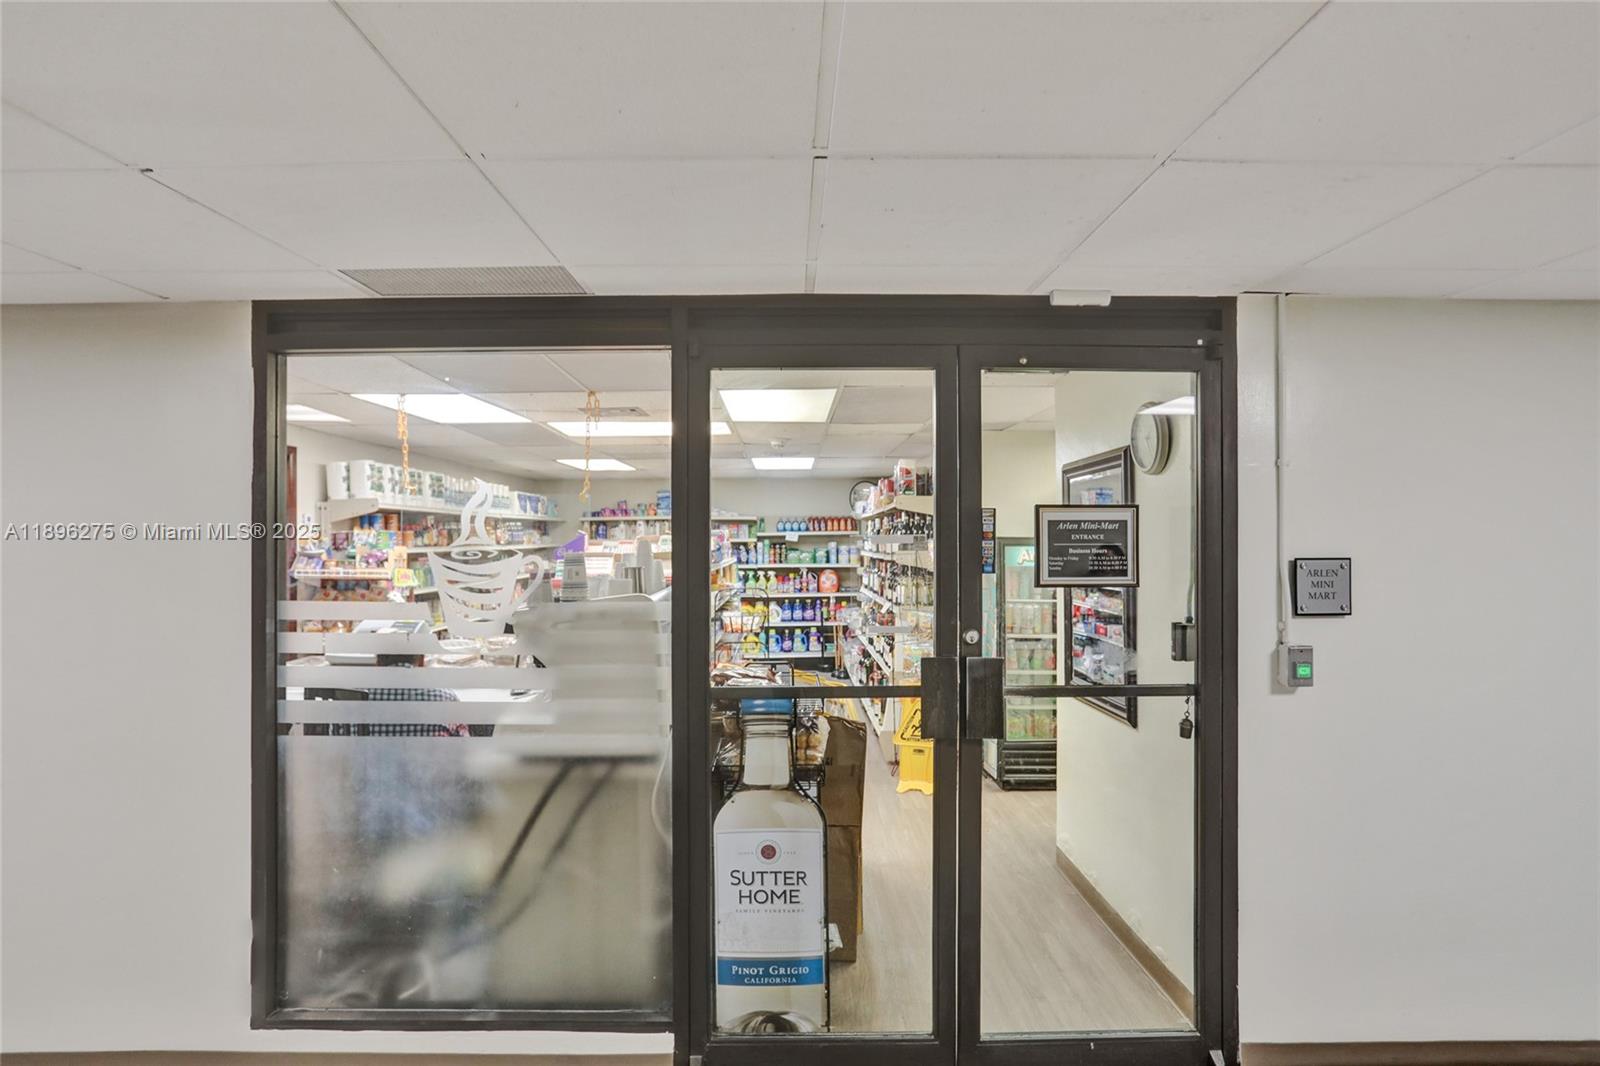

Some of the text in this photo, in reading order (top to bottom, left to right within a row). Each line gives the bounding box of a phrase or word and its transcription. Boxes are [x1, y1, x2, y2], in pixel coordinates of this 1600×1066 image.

[1056, 521, 1119, 530] Arlen Mini-Mart
[1306, 569, 1339, 577] ARLEN
[1310, 580, 1335, 589] MINI
[1308, 592, 1337, 600] MART
[730, 869, 808, 886] SUTTER
[738, 889, 801, 905] HOME
[731, 965, 810, 975] PINOT GRIGIO
